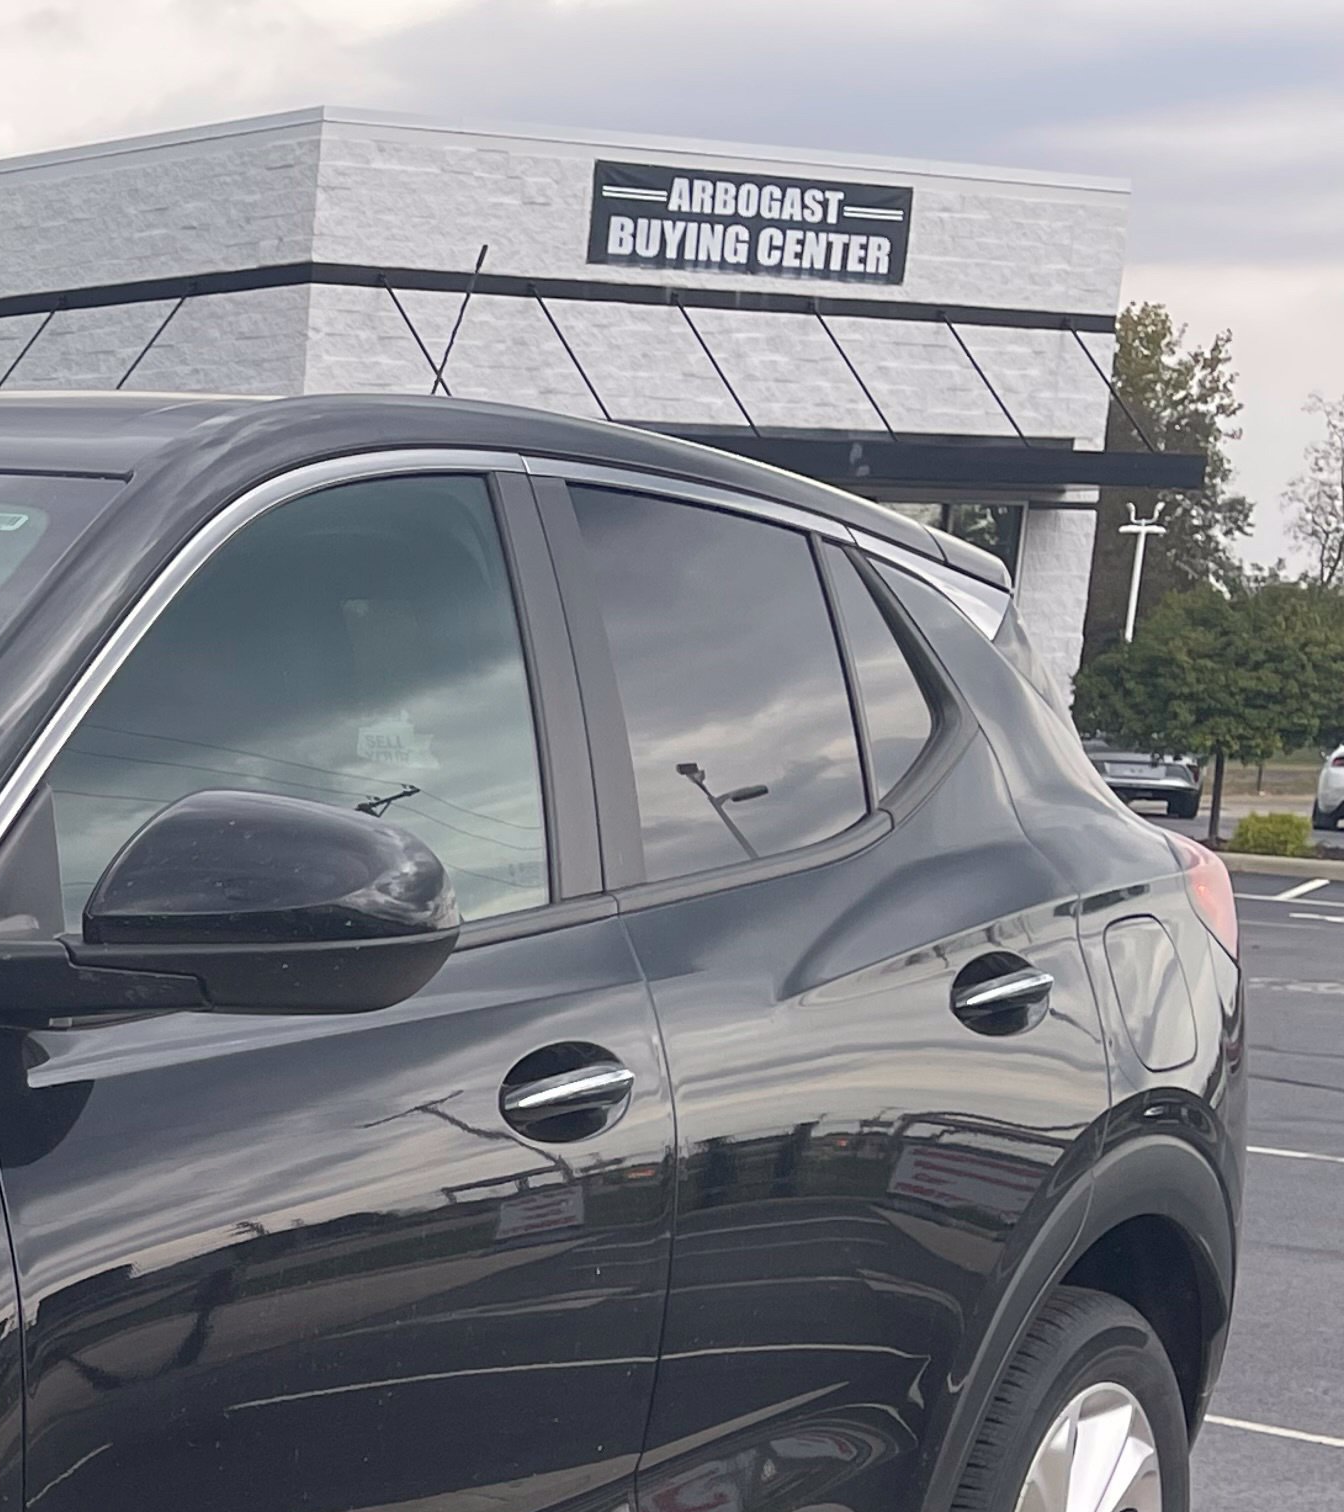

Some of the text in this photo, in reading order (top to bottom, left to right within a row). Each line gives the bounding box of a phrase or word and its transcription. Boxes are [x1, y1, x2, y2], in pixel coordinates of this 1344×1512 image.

[667, 177, 845, 224] ARBOGAST
[607, 215, 892, 275] BUYING CENTER
